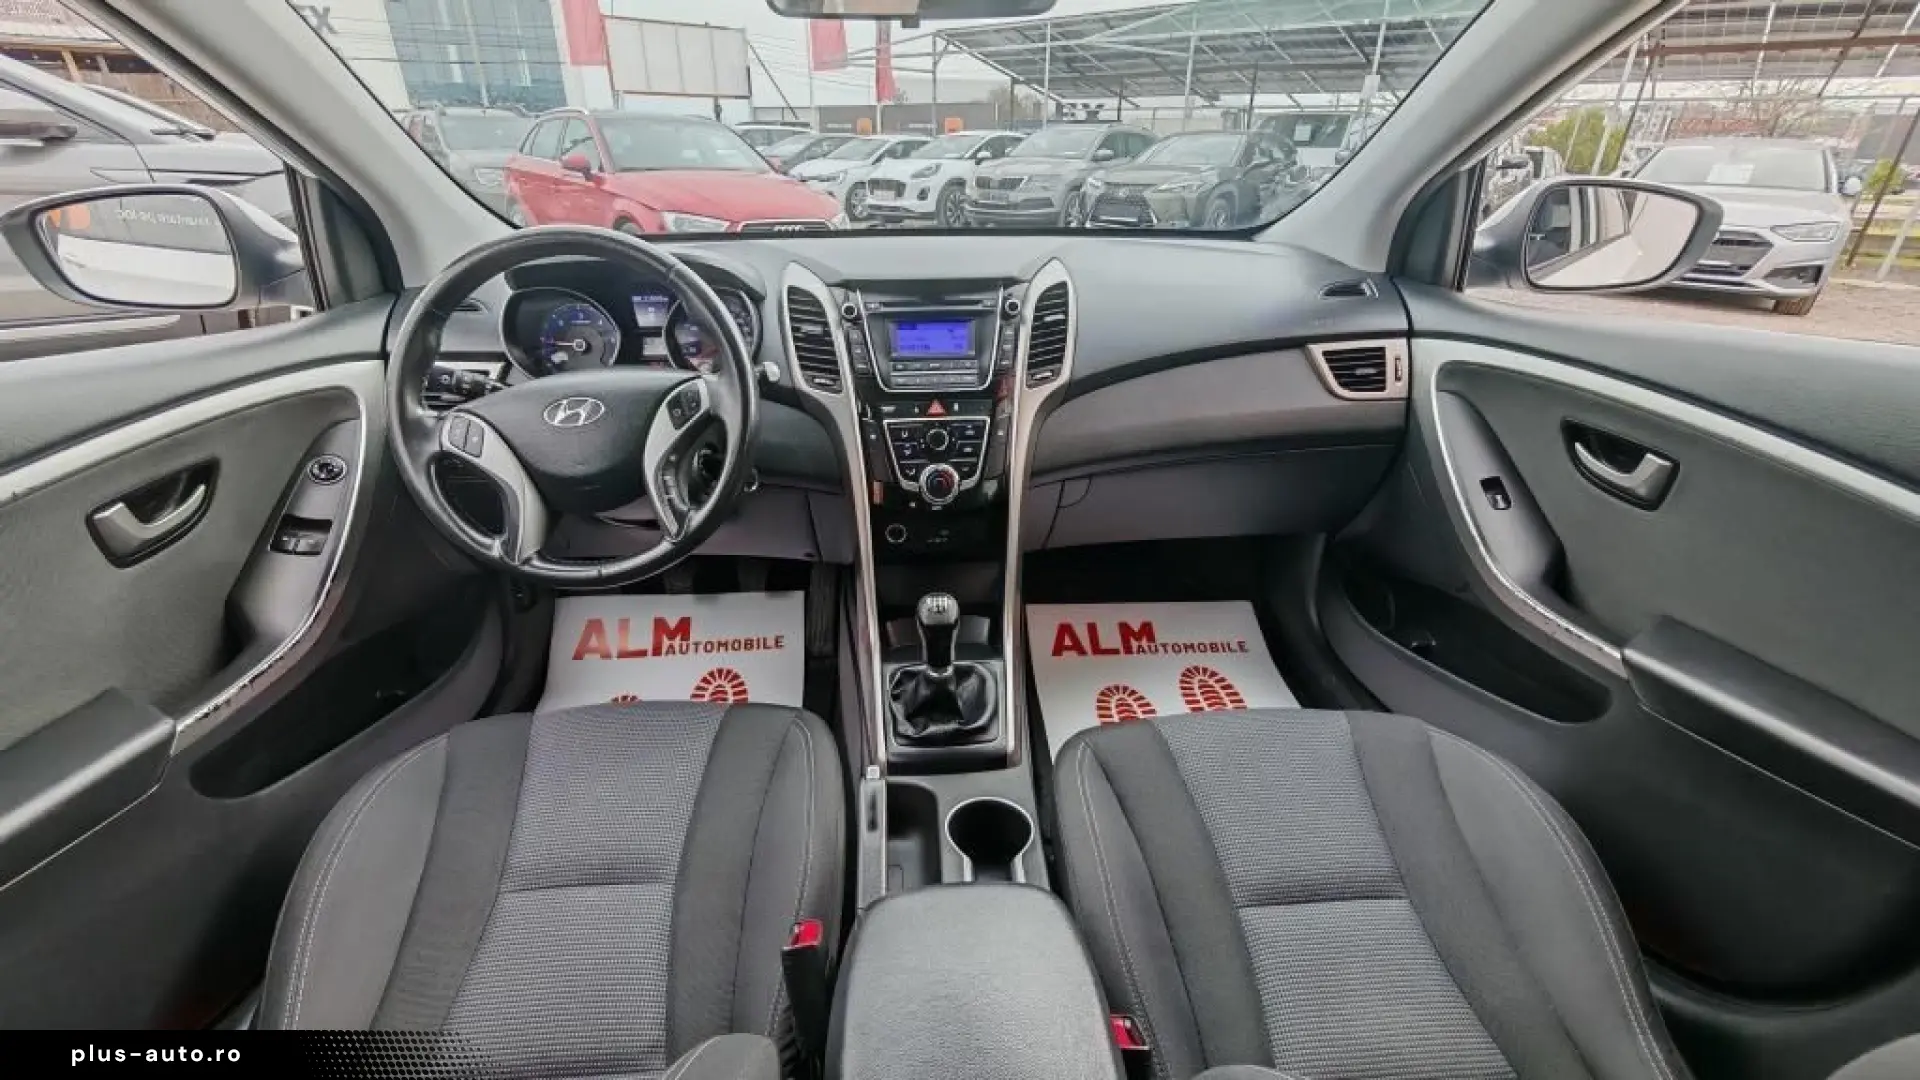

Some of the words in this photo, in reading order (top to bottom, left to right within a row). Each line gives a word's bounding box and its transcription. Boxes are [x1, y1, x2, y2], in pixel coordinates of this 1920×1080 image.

[572, 615, 692, 661] ALM
[664, 635, 785, 656] AUTOMOBILE
[1051, 620, 1156, 657] ALM
[1135, 640, 1249, 655] AUTOMOBILE
